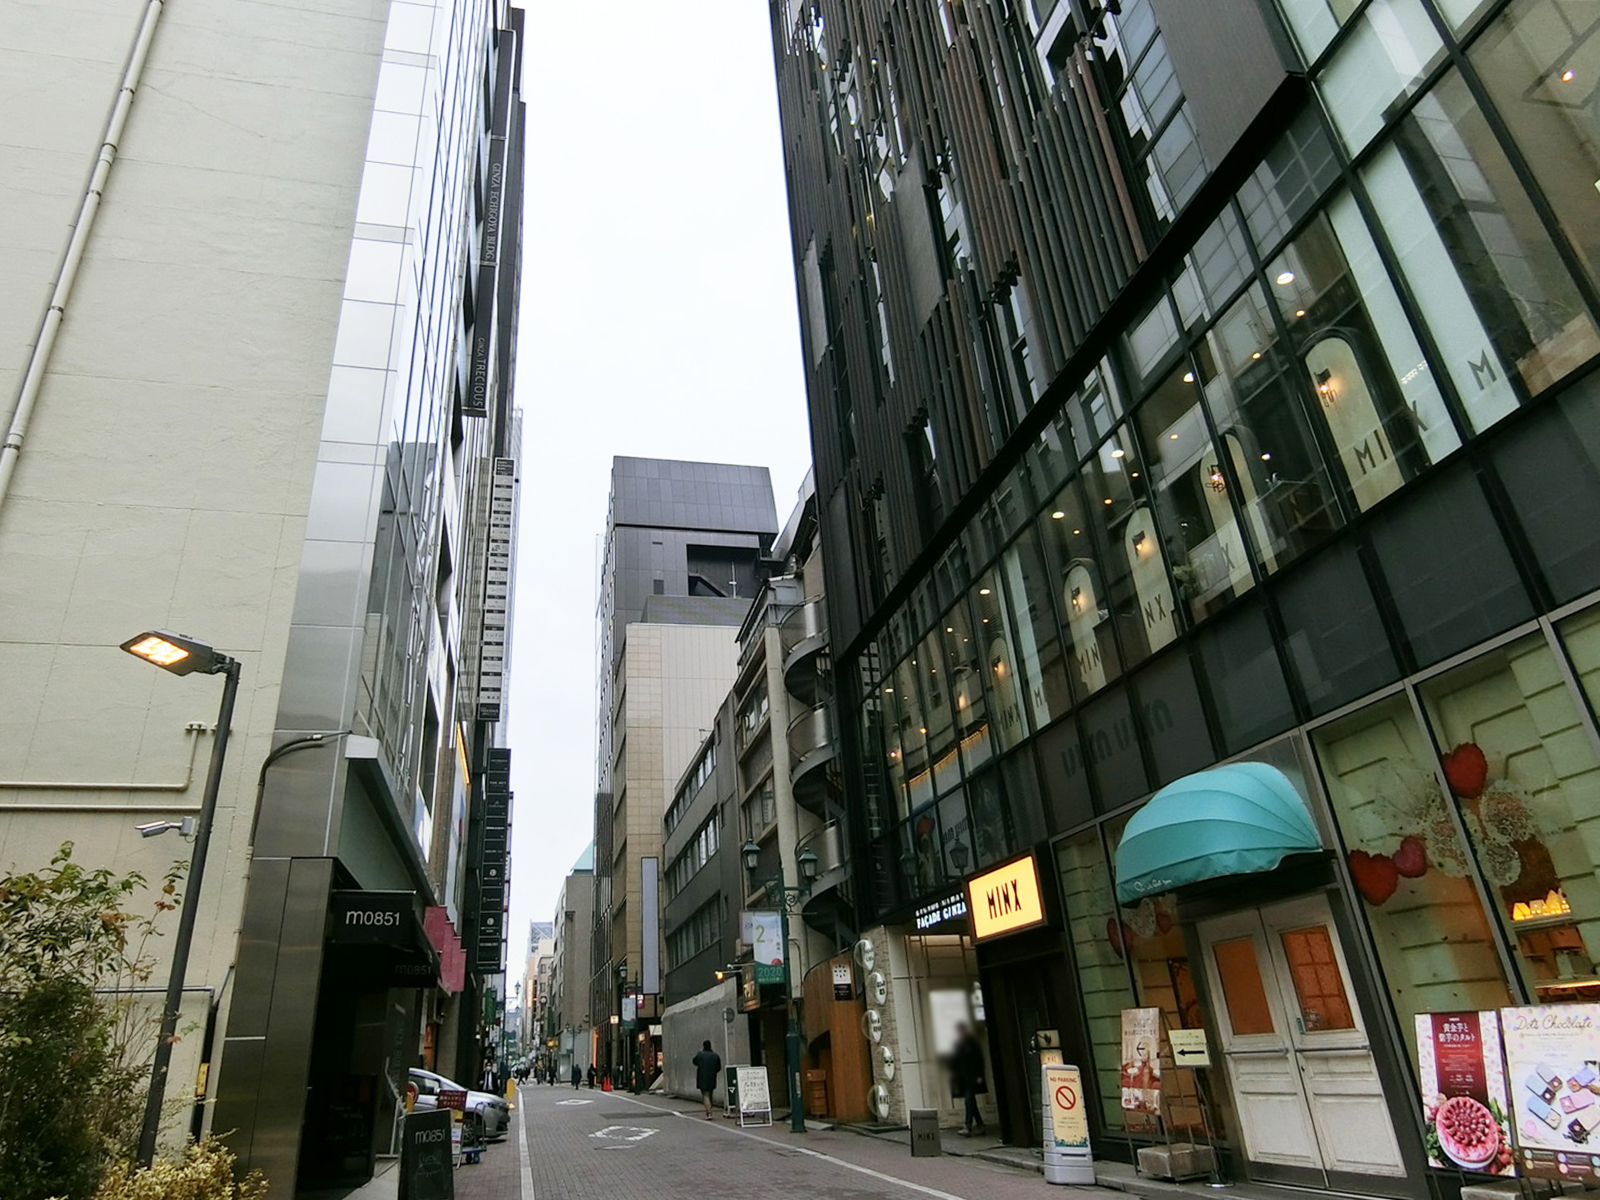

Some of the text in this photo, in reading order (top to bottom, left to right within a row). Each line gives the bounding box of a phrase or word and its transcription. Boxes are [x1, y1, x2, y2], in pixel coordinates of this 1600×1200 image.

[484, 162, 502, 261] GINZA ECHIGOYA BLDG.
[472, 358, 486, 407] TRECIOUS
[986, 878, 1022, 920] MINX
[345, 909, 401, 927] m0851
[942, 901, 967, 919] GINZA
[755, 924, 766, 943] 2
[758, 966, 783, 978] 2020
[1513, 1014, 1594, 1031] Dots Chocolate
